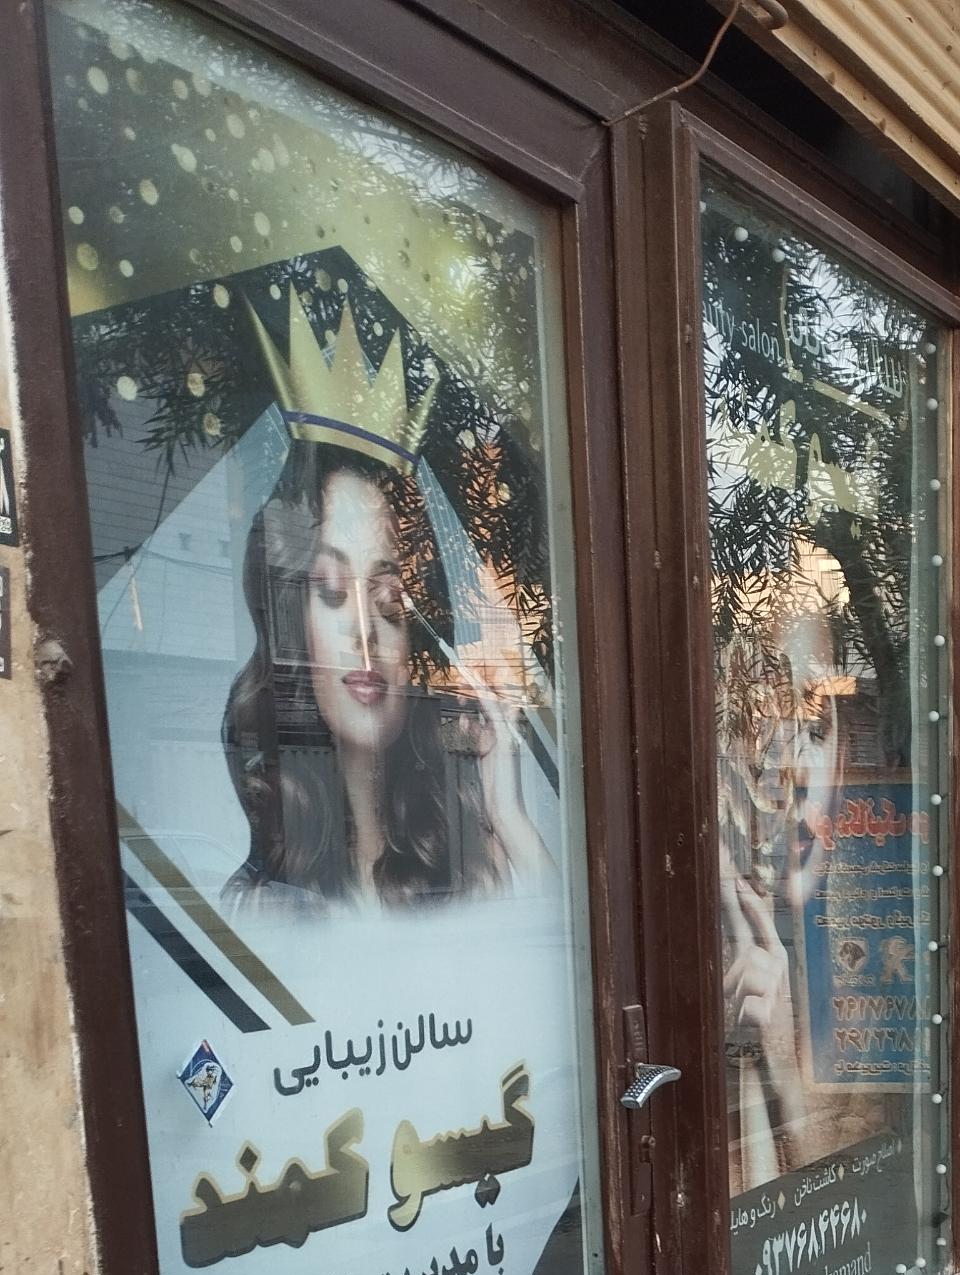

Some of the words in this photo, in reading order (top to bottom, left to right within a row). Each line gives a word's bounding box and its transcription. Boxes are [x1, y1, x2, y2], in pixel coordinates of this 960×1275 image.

[273, 1018, 384, 1097] زیبایی
[392, 1013, 472, 1071] سالن
[388, 1060, 535, 1232] گیسو
[180, 1107, 368, 1268] کمند
[794, 1178, 813, 1206] ناخن
[814, 1164, 837, 1190] کاشت
[757, 1194, 776, 1219] رنگ
[485, 1223, 504, 1275] با
